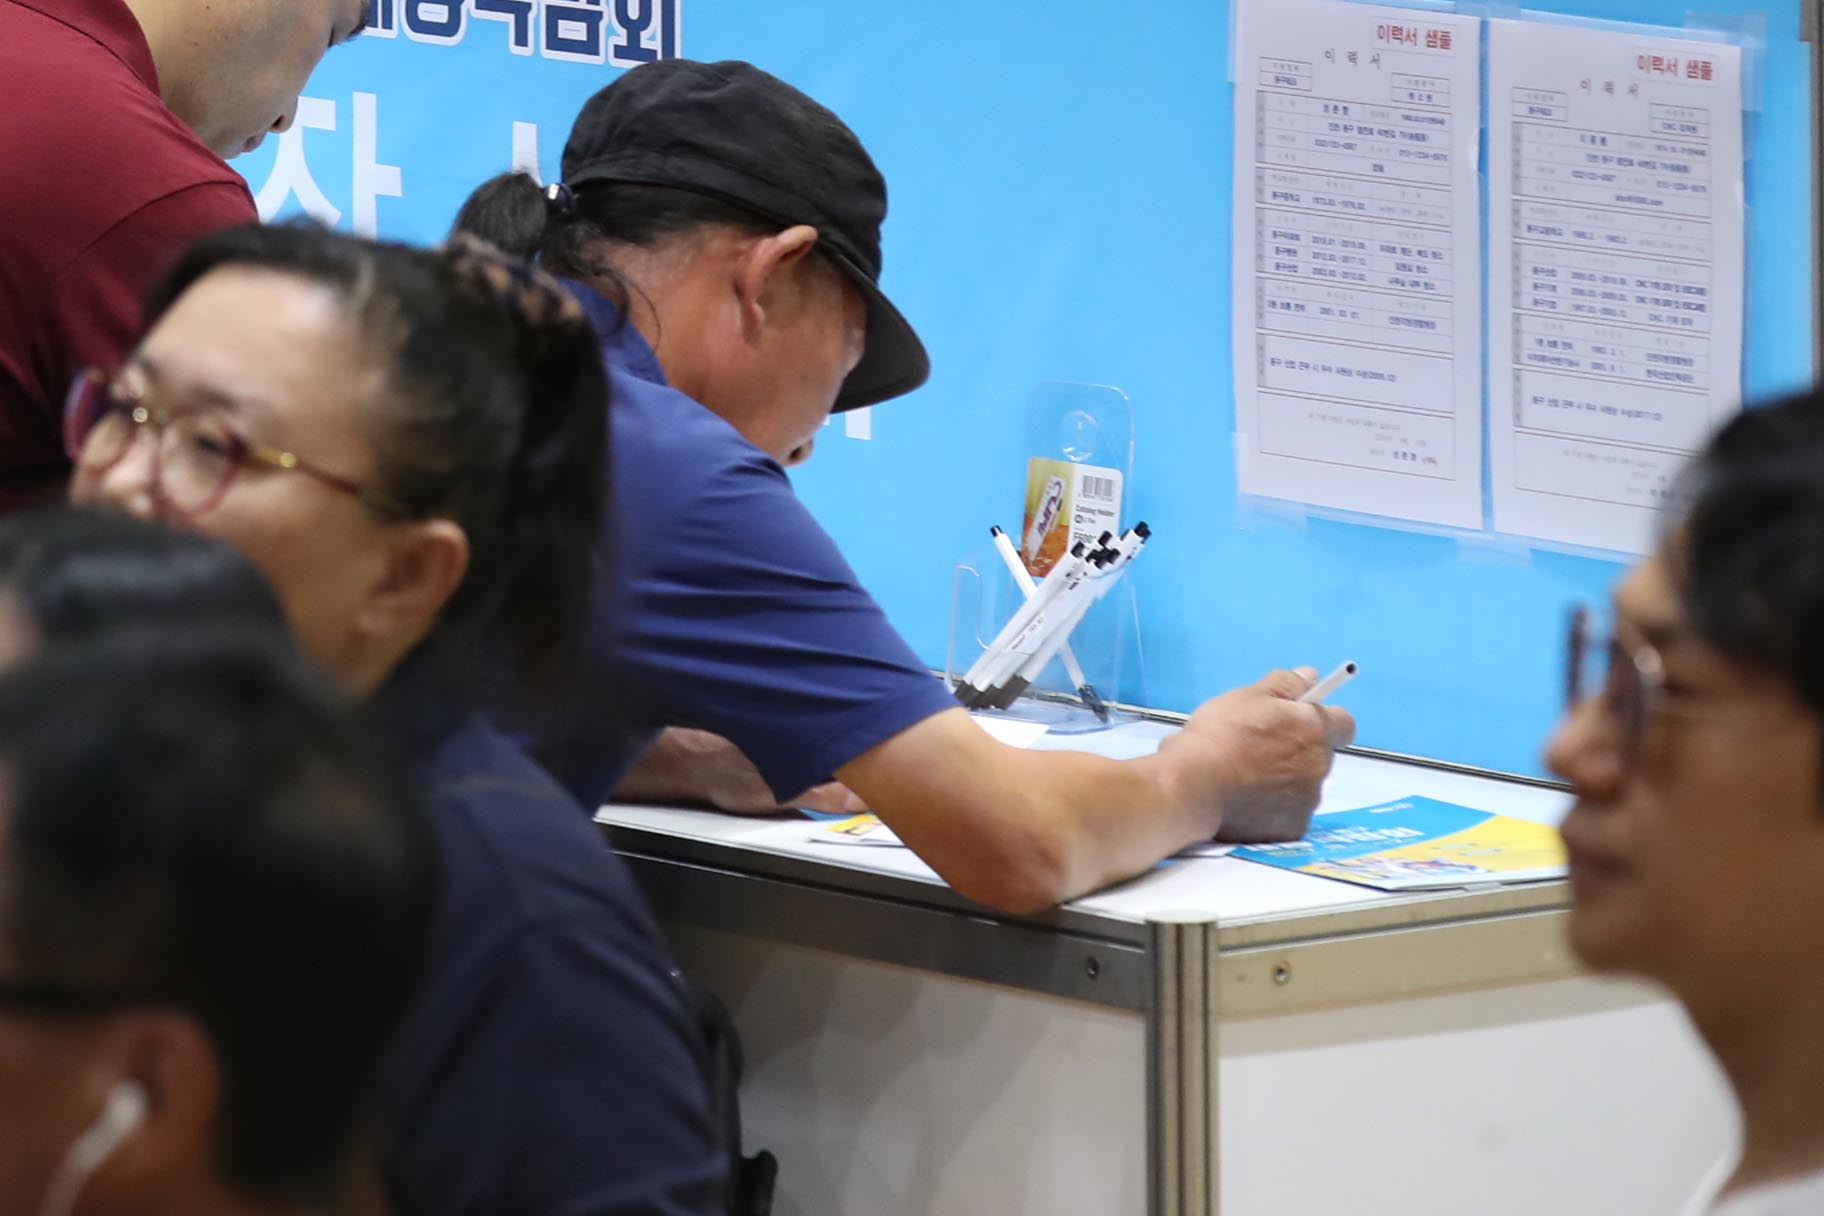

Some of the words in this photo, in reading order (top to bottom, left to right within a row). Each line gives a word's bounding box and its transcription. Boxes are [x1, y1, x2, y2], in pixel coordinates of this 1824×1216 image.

[1376, 23, 1418, 47] 이력서
[1425, 29, 1452, 50] 샘플
[1636, 54, 1678, 77] 이력서
[1687, 59, 1713, 81] 샘플
